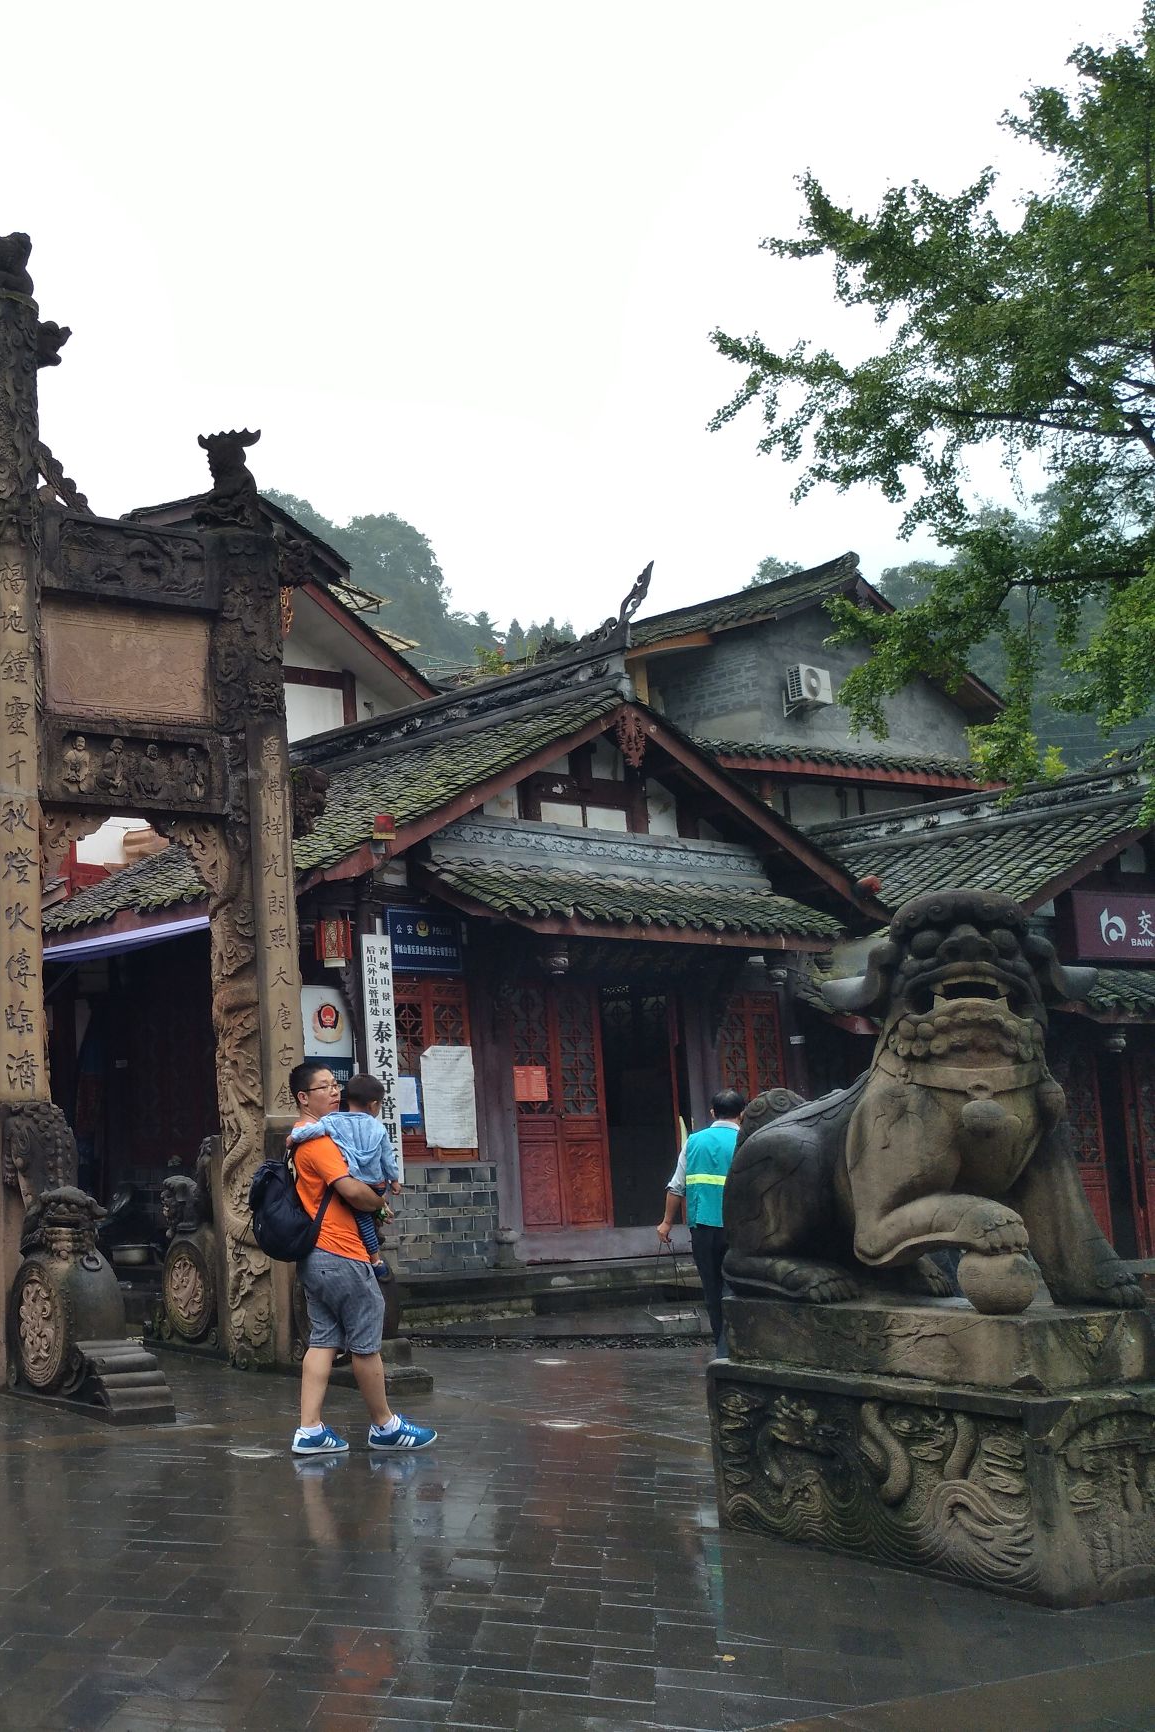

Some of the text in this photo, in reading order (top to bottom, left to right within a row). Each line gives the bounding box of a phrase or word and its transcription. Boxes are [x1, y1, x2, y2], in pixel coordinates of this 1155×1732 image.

[395, 924, 414, 935] 公安
[1131, 938, 1154, 948] BANK
[379, 946, 392, 1017] 青城山景区
